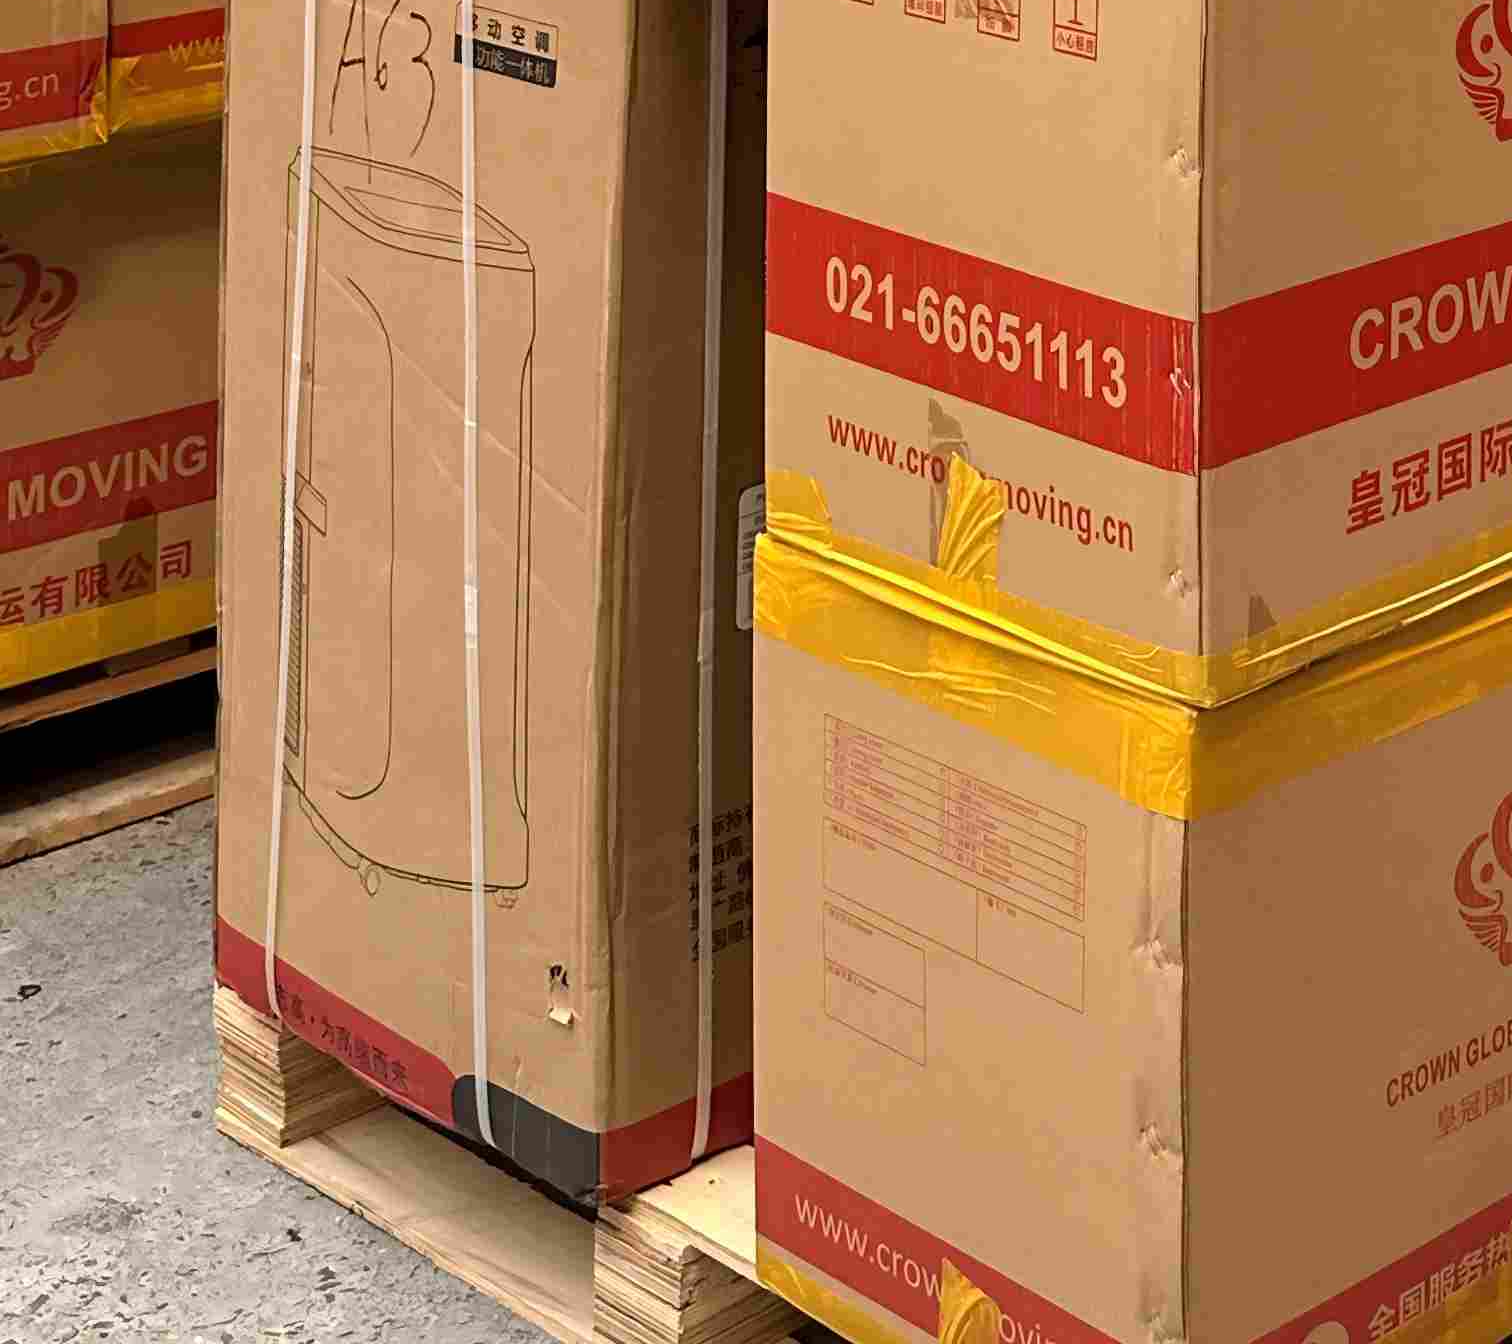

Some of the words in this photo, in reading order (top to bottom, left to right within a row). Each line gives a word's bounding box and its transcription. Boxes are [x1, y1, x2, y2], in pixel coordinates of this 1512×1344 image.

[825, 255, 1128, 409] 021-66651113
[7, 432, 210, 522] MOVING
[1385, 1038, 1461, 1109] CROWN
